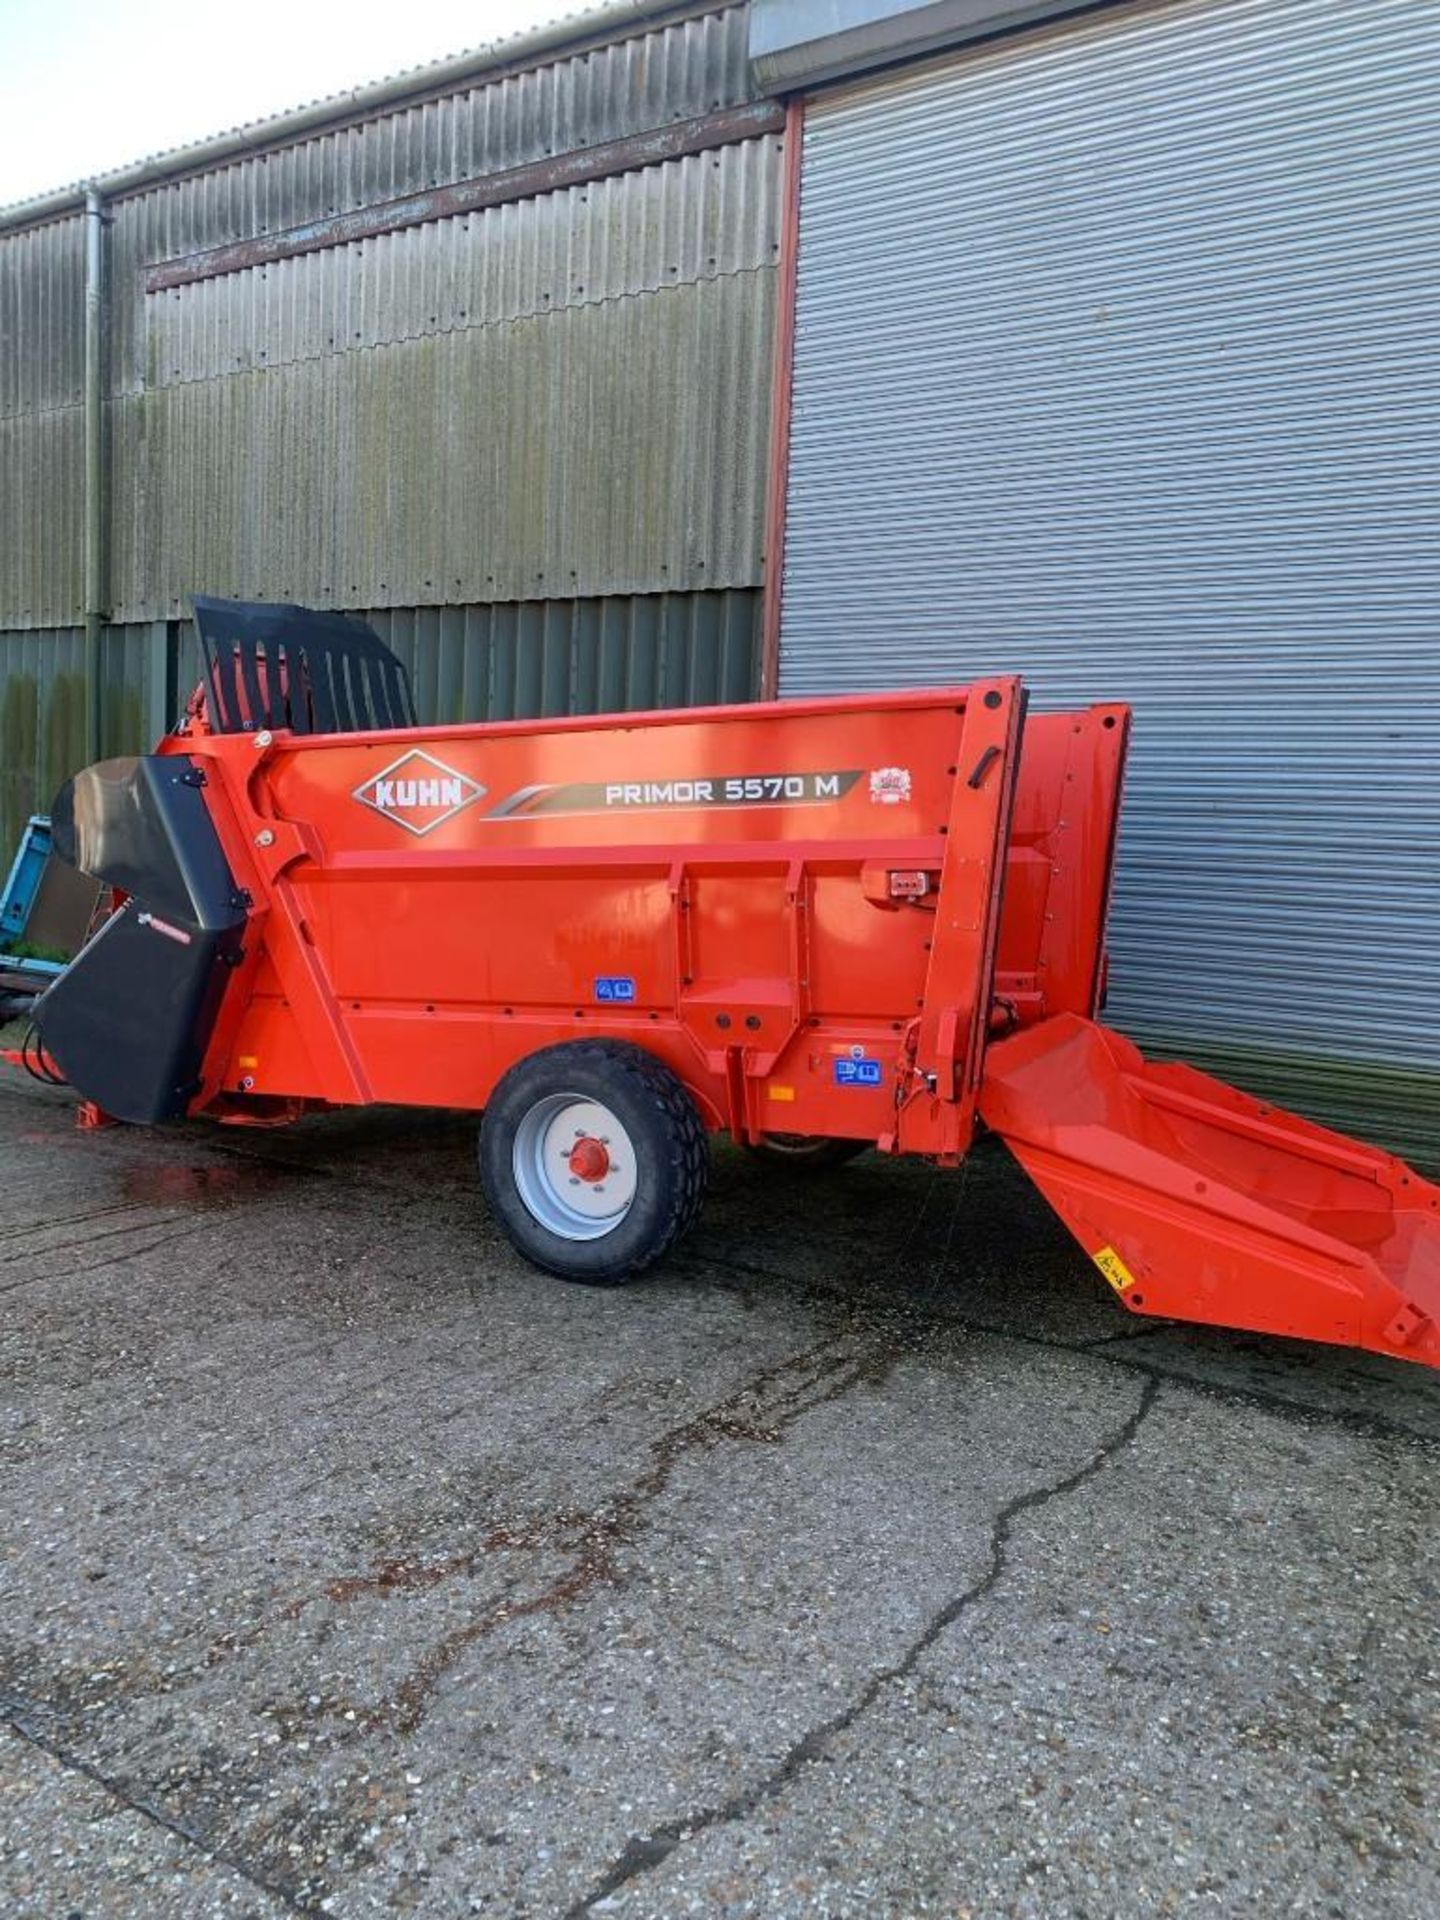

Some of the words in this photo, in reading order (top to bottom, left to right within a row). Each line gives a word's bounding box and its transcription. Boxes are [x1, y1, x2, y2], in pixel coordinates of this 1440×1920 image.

[375, 778, 462, 807] KUHN
[605, 782, 715, 805] PRIMOR
[725, 777, 804, 800] 5570
[815, 775, 839, 797] M
